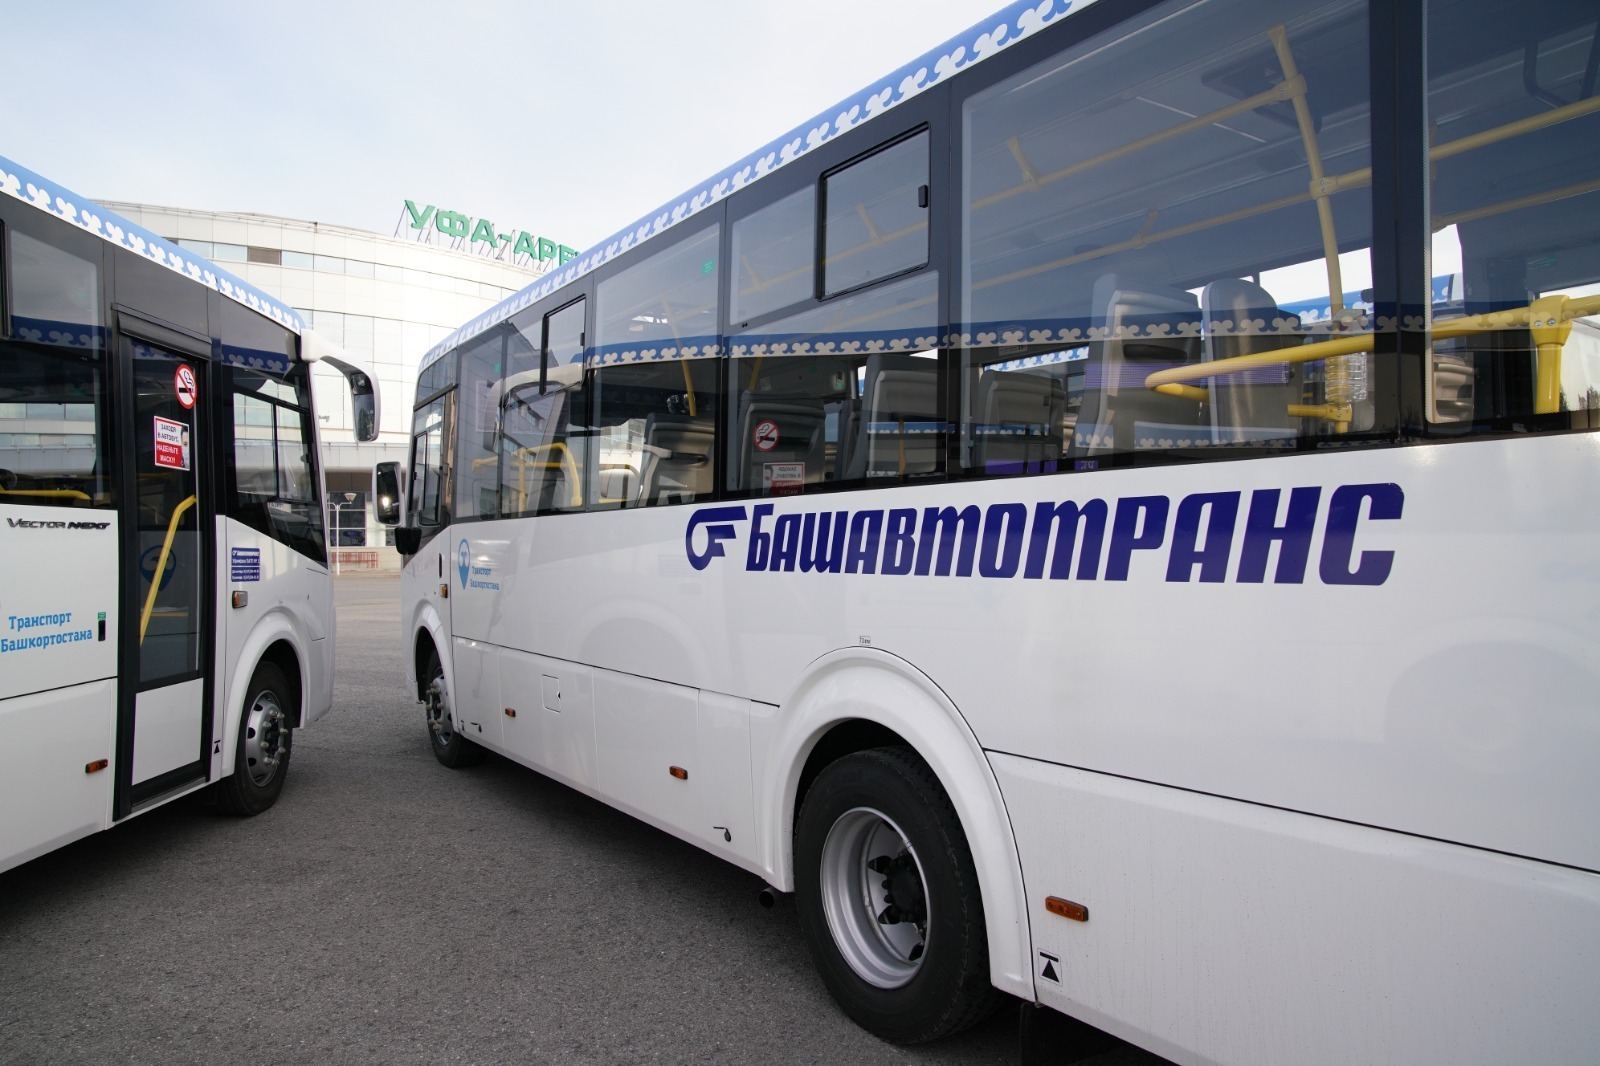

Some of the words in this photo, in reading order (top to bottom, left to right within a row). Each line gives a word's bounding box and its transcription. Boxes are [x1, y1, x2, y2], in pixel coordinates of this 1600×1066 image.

[404, 199, 581, 267] УФА-АРЕ
[67, 521, 111, 530] NEXT
[8, 612, 72, 632] Транспорт
[0, 629, 93, 653] Башкортостана
